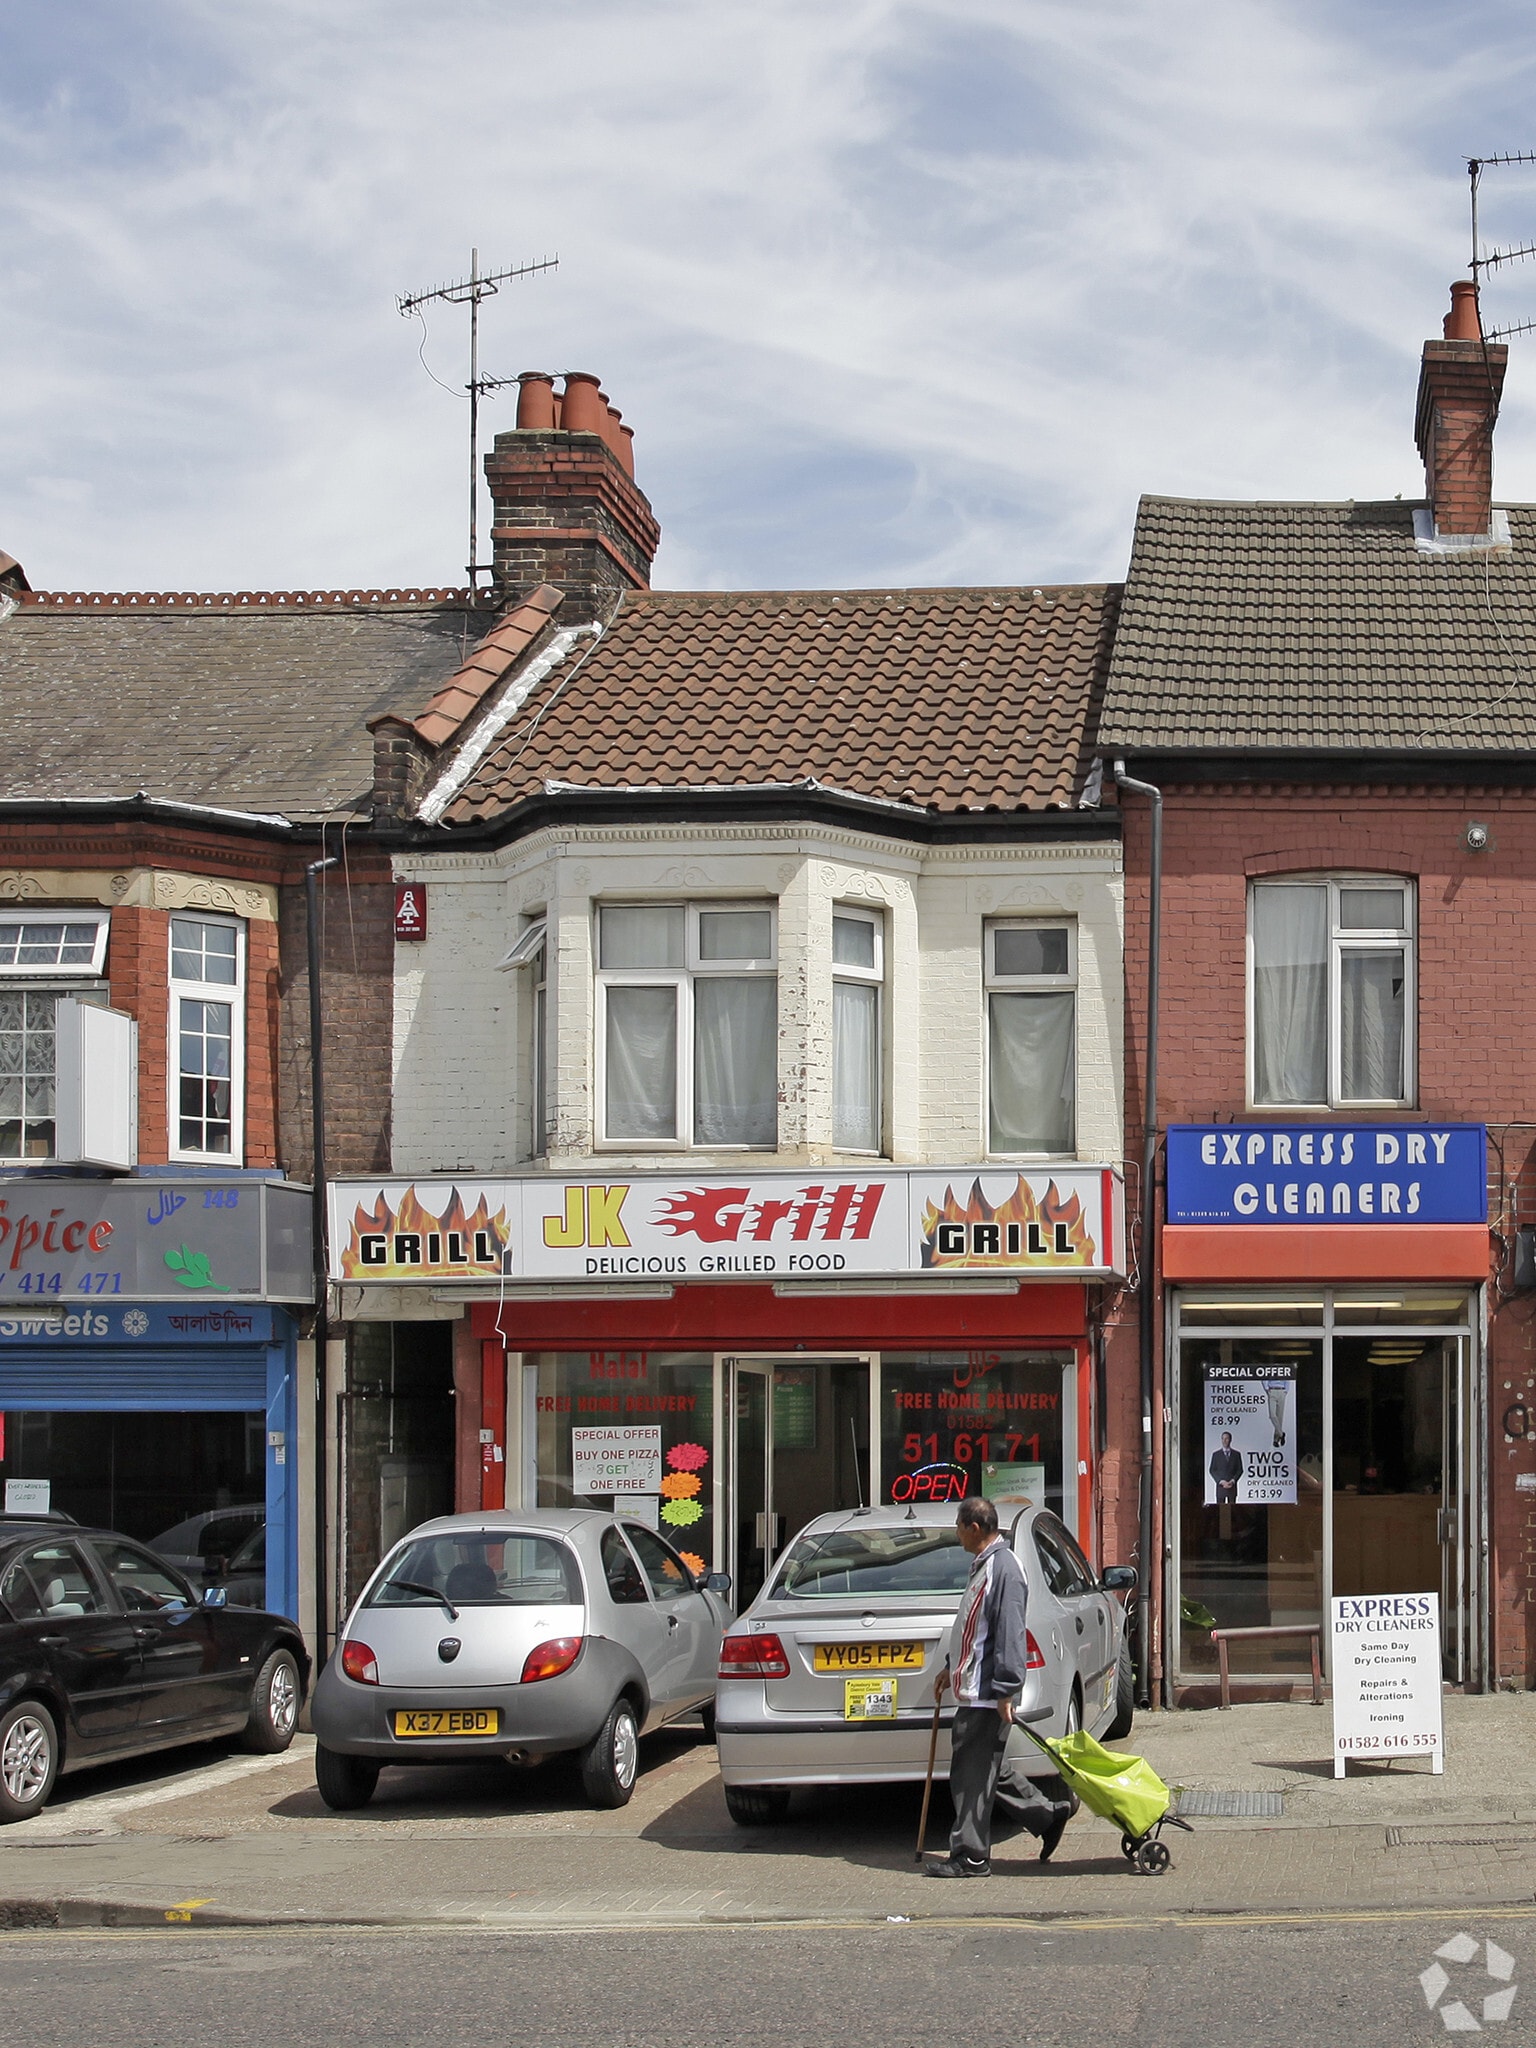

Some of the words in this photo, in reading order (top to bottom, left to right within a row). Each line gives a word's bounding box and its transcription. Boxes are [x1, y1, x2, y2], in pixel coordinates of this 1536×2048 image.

[1201, 1133, 1355, 1165] EXPRESS
[1376, 1133, 1451, 1165] DRY
[202, 1189, 239, 1209] 148
[1233, 1182, 1421, 1214] CLEANERS
[147, 1189, 187, 1225] حلال
[543, 1184, 632, 1248] JK
[650, 1184, 887, 1243] Grill
[937, 1222, 1075, 1254] GRILL
[360, 1232, 495, 1265] GRILL
[586, 1257, 687, 1275] DELICIOUS
[700, 1255, 776, 1272] GRILLED
[788, 1254, 846, 1271] FOOD
[18, 1272, 62, 1294] 414
[78, 1272, 122, 1294] 471
[589, 1351, 648, 1379] Halal
[1209, 1367, 1253, 1378] SPECIAL
[1255, 1366, 1292, 1377] OFFER
[1210, 1384, 1245, 1394] THREE
[536, 1396, 573, 1413] FREE
[577, 1396, 620, 1413] HOME
[626, 1395, 698, 1413] DELIVERY
[894, 1392, 933, 1410] FREE
[937, 1392, 981, 1410] HOME
[987, 1392, 1060, 1410] DELIVERY
[1210, 1395, 1266, 1405] TROUSERS
[946, 1414, 994, 1430] 01582
[1211, 1415, 1241, 1426] £8.99
[574, 1430, 621, 1441] SPECIAL
[623, 1429, 659, 1440] OFFER
[575, 1450, 598, 1461] BUY
[601, 1450, 625, 1460] ONE
[628, 1449, 660, 1460] PIZZA
[903, 1432, 939, 1463] 51
[954, 1432, 990, 1463] 61
[1004, 1432, 1041, 1463] 71
[1247, 1451, 1284, 1465] TWO
[606, 1464, 629, 1475] GET
[1247, 1465, 1290, 1478] SUITS
[590, 1479, 614, 1490] ONE
[617, 1478, 646, 1489] FREE
[891, 1474, 969, 1501] OPEN
[1247, 1489, 1283, 1499] £13.99
[1339, 1597, 1431, 1619] EXPRESS
[1335, 1621, 1363, 1634] DRY
[1366, 1618, 1435, 1632] CLEANERS
[1360, 1642, 1388, 1651] Same
[1391, 1641, 1410, 1651] Day
[823, 1647, 872, 1666] YY05
[877, 1644, 915, 1664] FPZ
[1354, 1656, 1372, 1666] Dry
[1374, 1655, 1417, 1664] Cleaning
[1360, 1679, 1398, 1690] Repairs
[1401, 1678, 1408, 1687] &
[867, 1694, 893, 1704] 1343
[1359, 1692, 1414, 1702] Alterations
[405, 1713, 444, 1732] X37
[448, 1712, 488, 1731] EBD
[1369, 1713, 1405, 1723] Ironing
[1338, 1736, 1380, 1750] 01582
[1384, 1735, 1409, 1748] 616
[1412, 1733, 1437, 1747] 555
